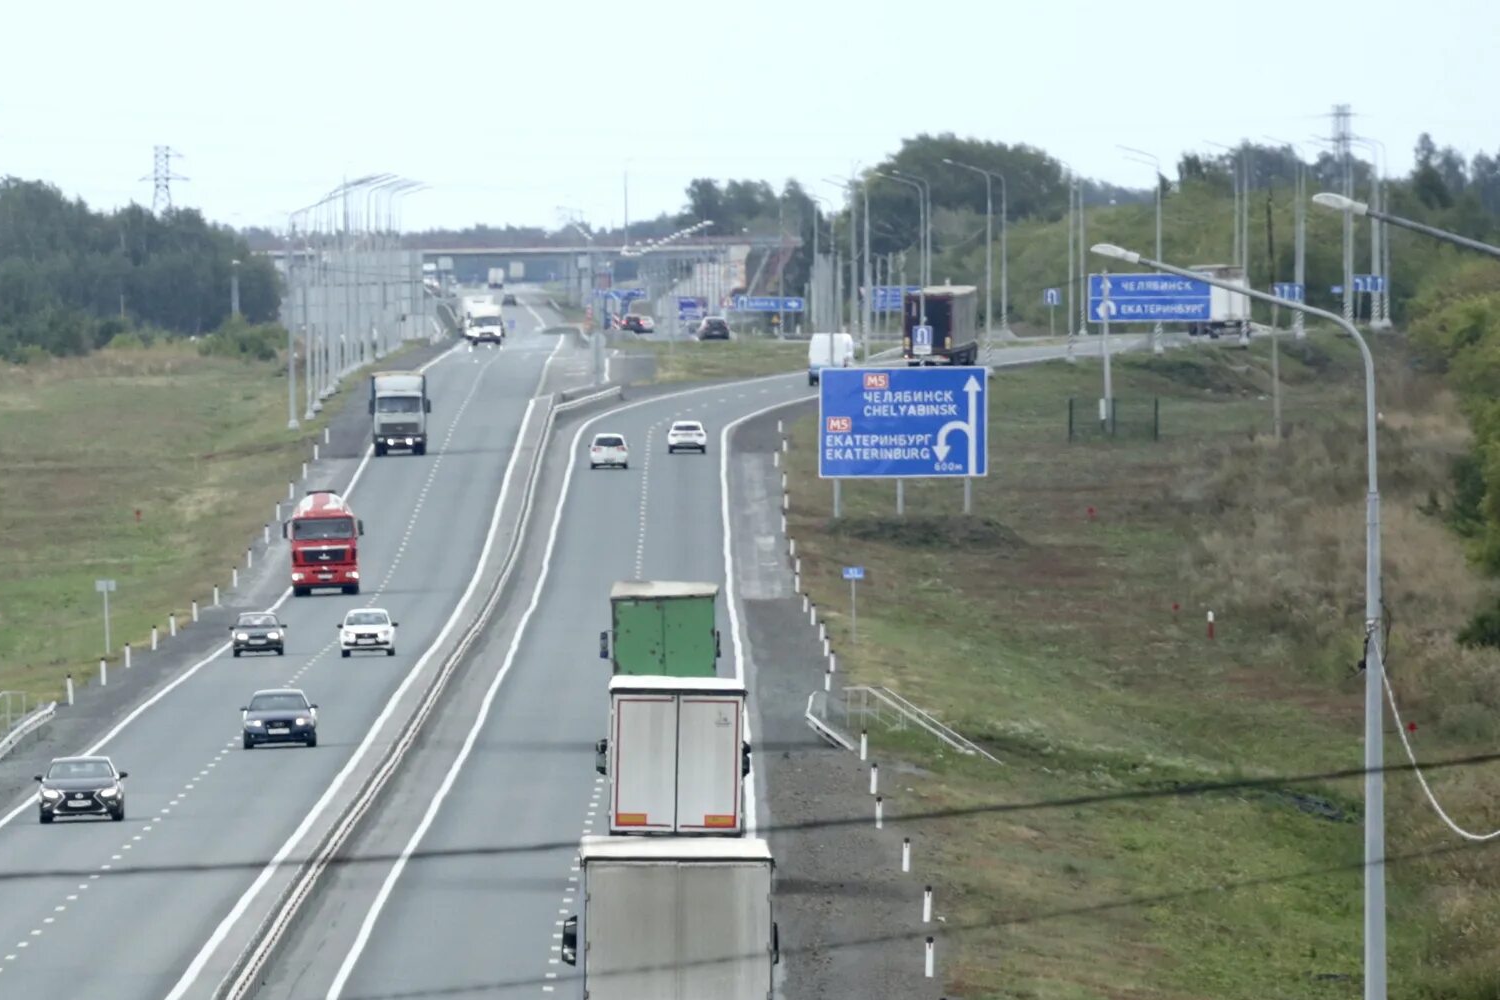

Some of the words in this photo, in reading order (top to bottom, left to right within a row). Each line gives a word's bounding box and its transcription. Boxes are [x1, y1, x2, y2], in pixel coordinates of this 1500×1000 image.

[1121, 281, 1193, 291] ЧЕЛЯБИНСК
[1120, 303, 1205, 314] ЕКАТЕРИНБУРГ
[867, 375, 886, 387] М5
[863, 390, 953, 403] ЧЕЛЯБИНСК
[863, 404, 958, 417] CHELYABINSK
[829, 419, 849, 430] М5
[826, 434, 932, 446] ЕКАТЕРИНБУРГ
[826, 448, 931, 460] EKATERINBURG
